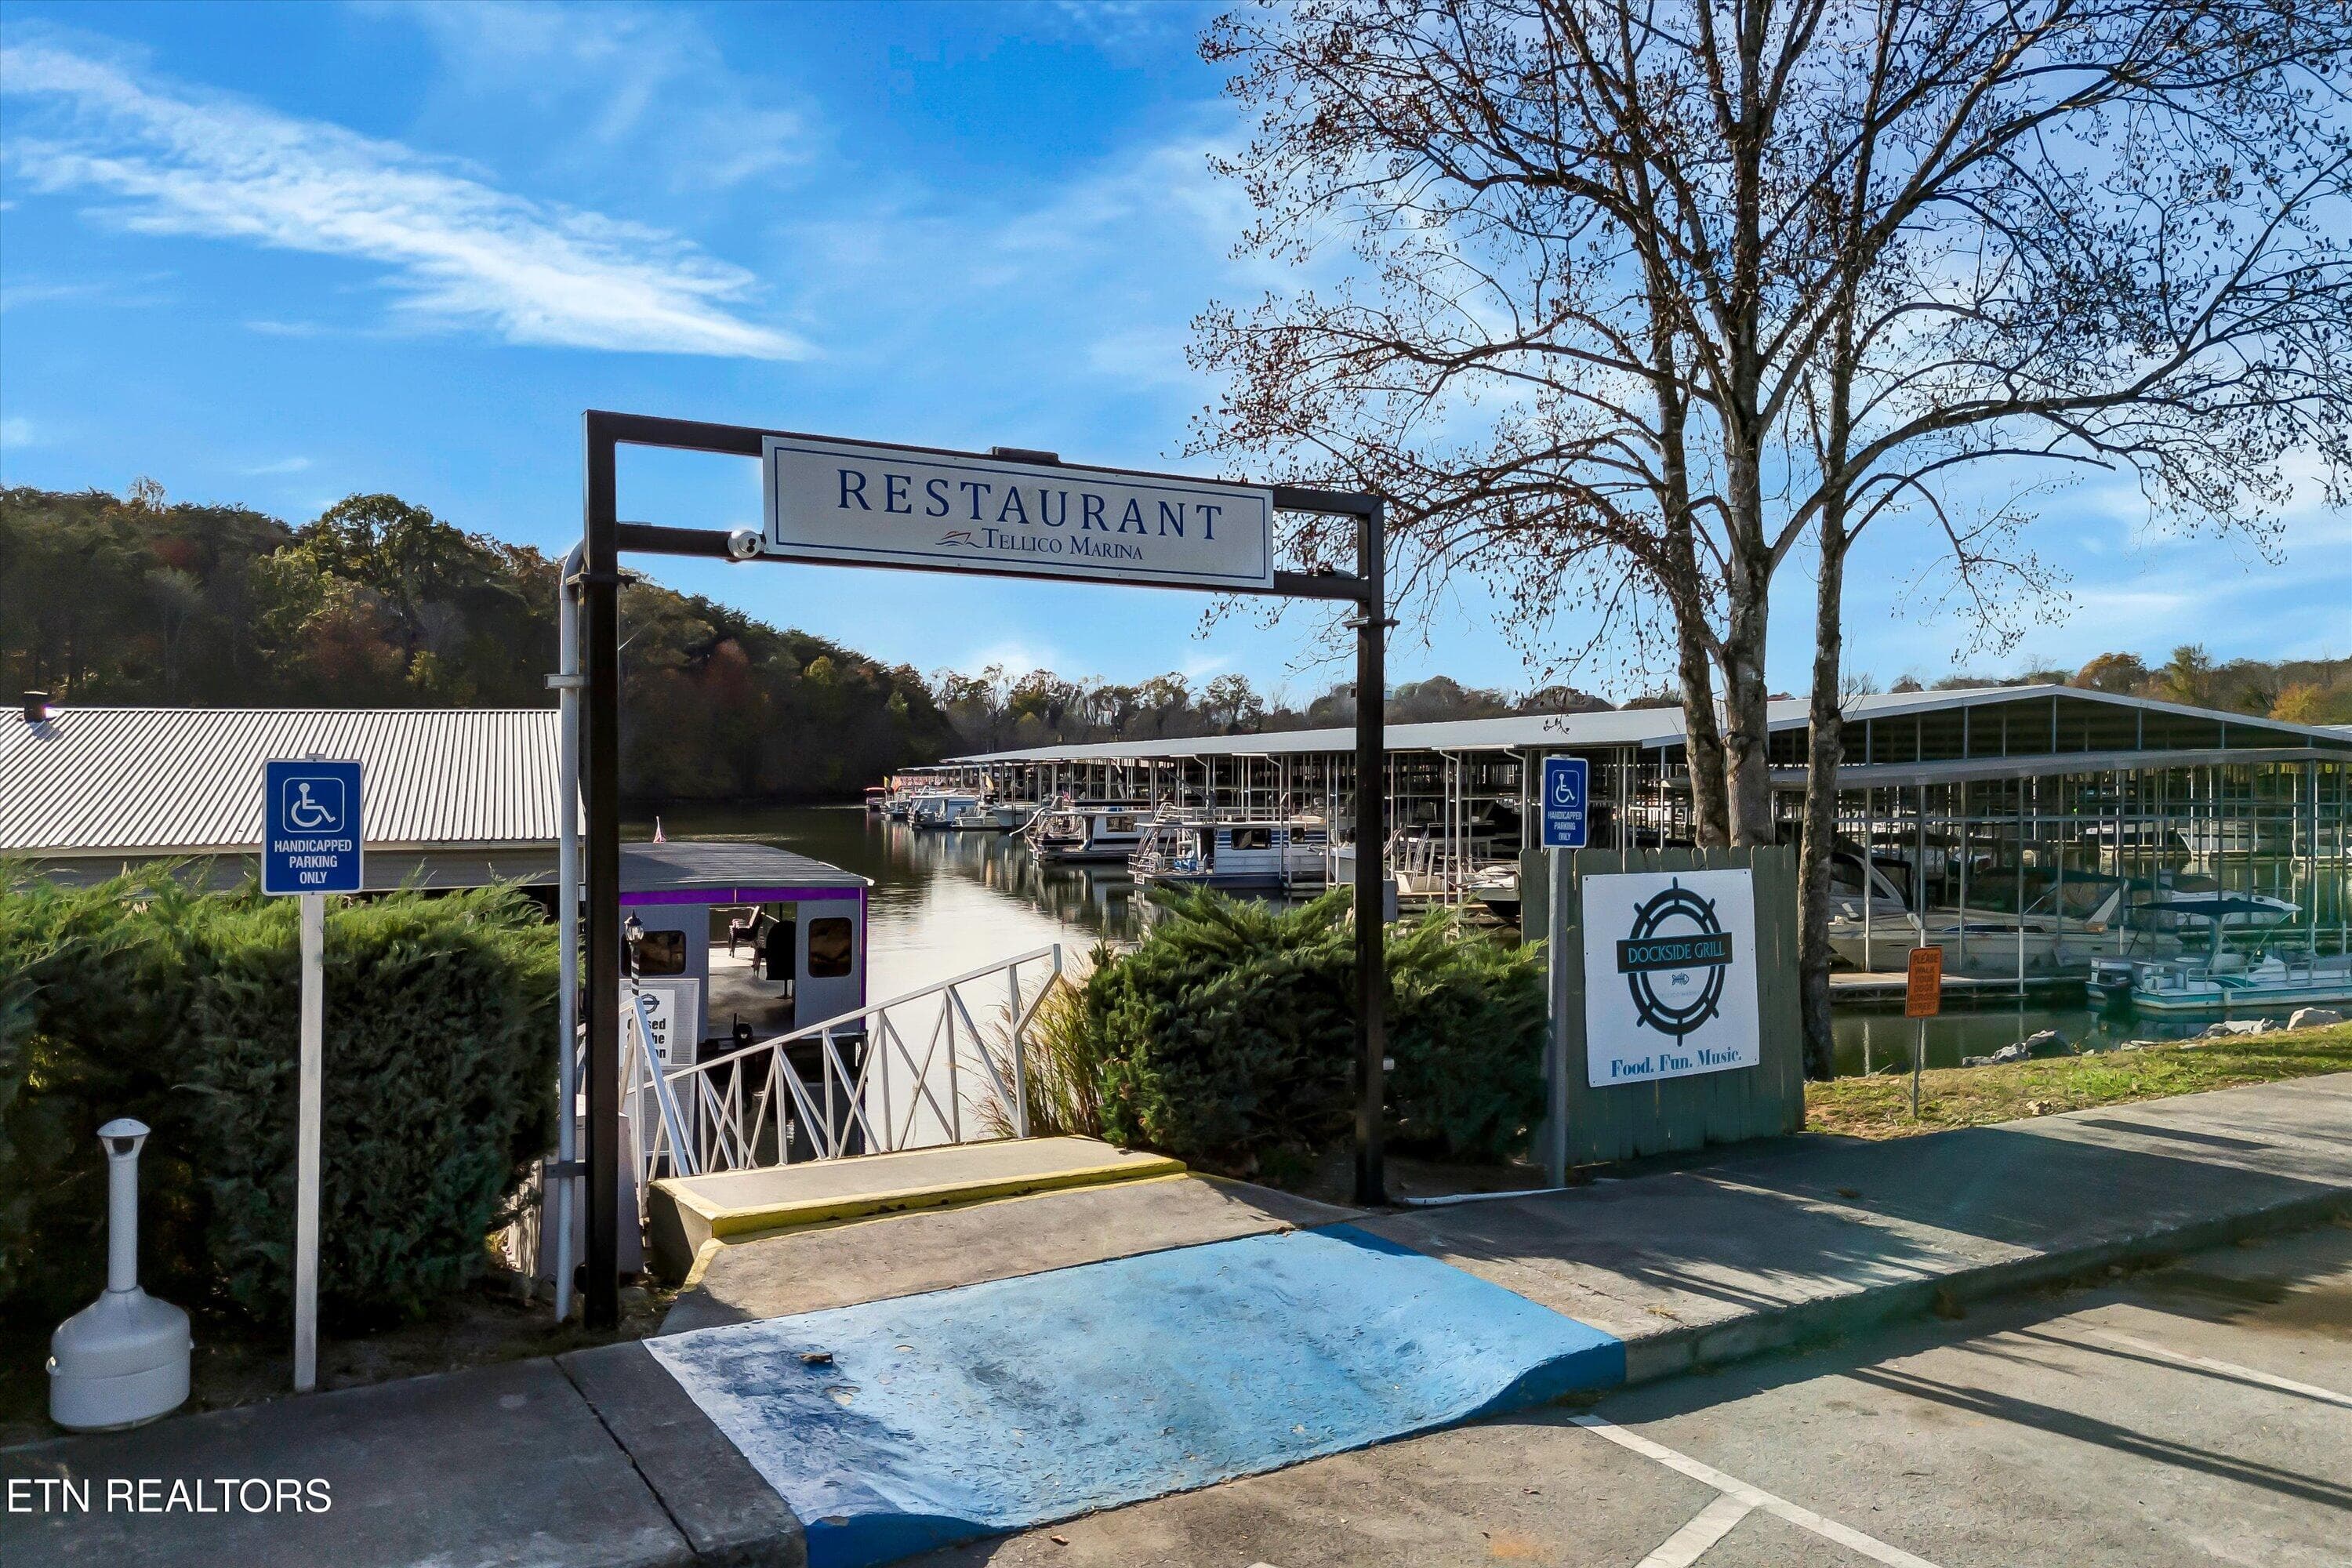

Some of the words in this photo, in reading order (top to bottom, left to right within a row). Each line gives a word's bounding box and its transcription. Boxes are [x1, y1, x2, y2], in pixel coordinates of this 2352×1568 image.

[837, 470, 1222, 539] RESTAURANT
[981, 527, 1062, 554] TELLICO
[1069, 535, 1143, 561] MARINA
[1554, 822, 1576, 830] PARKING
[274, 840, 352, 852] HANDICAPPED
[289, 856, 337, 868] PARKING
[299, 872, 328, 884] ONLY
[1628, 944, 1692, 964] DOCKSIDE
[1694, 941, 1726, 956] GRILL
[1912, 954, 1939, 964] PLEASE
[1908, 1002, 1936, 1011] STREET
[1611, 1056, 1654, 1077] Food.
[1659, 1054, 1693, 1071] Fun.
[1697, 1047, 1742, 1067] Music.
